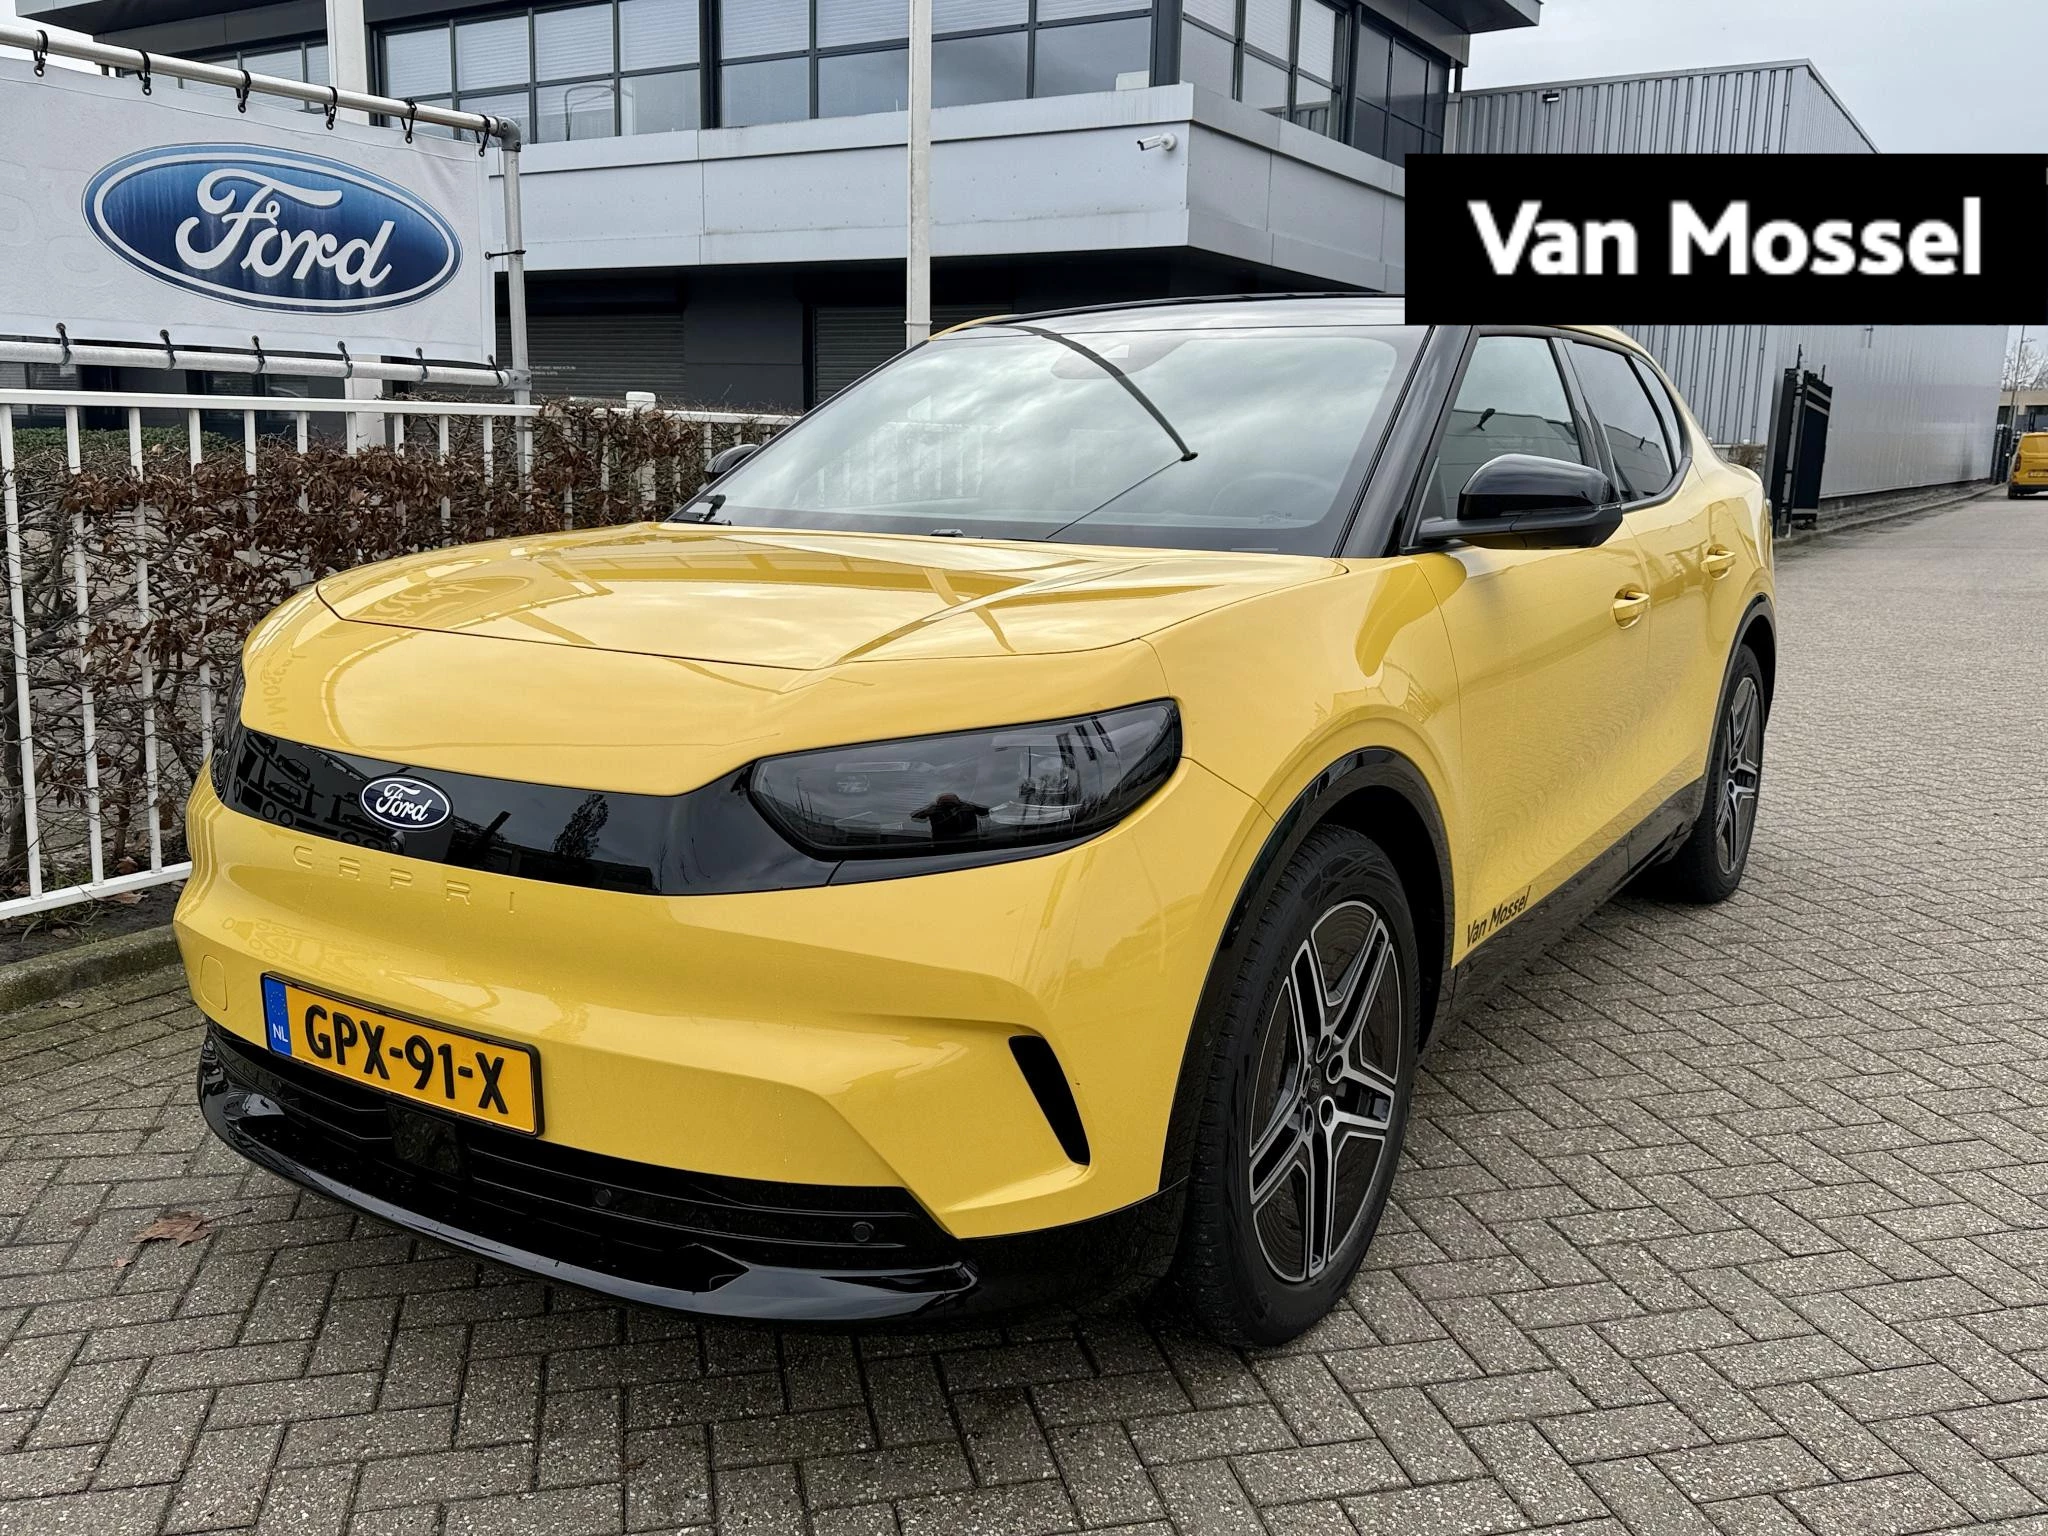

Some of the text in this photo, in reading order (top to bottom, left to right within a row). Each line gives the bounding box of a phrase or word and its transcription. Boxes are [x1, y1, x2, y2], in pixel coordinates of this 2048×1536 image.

[174, 168, 396, 289] Ford
[375, 783, 432, 822] Ford
[293, 845, 515, 914] CAPRI
[1467, 884, 1531, 948] Van Mossel
[272, 1023, 288, 1042] NL
[305, 1004, 509, 1114] GPX-91-X
